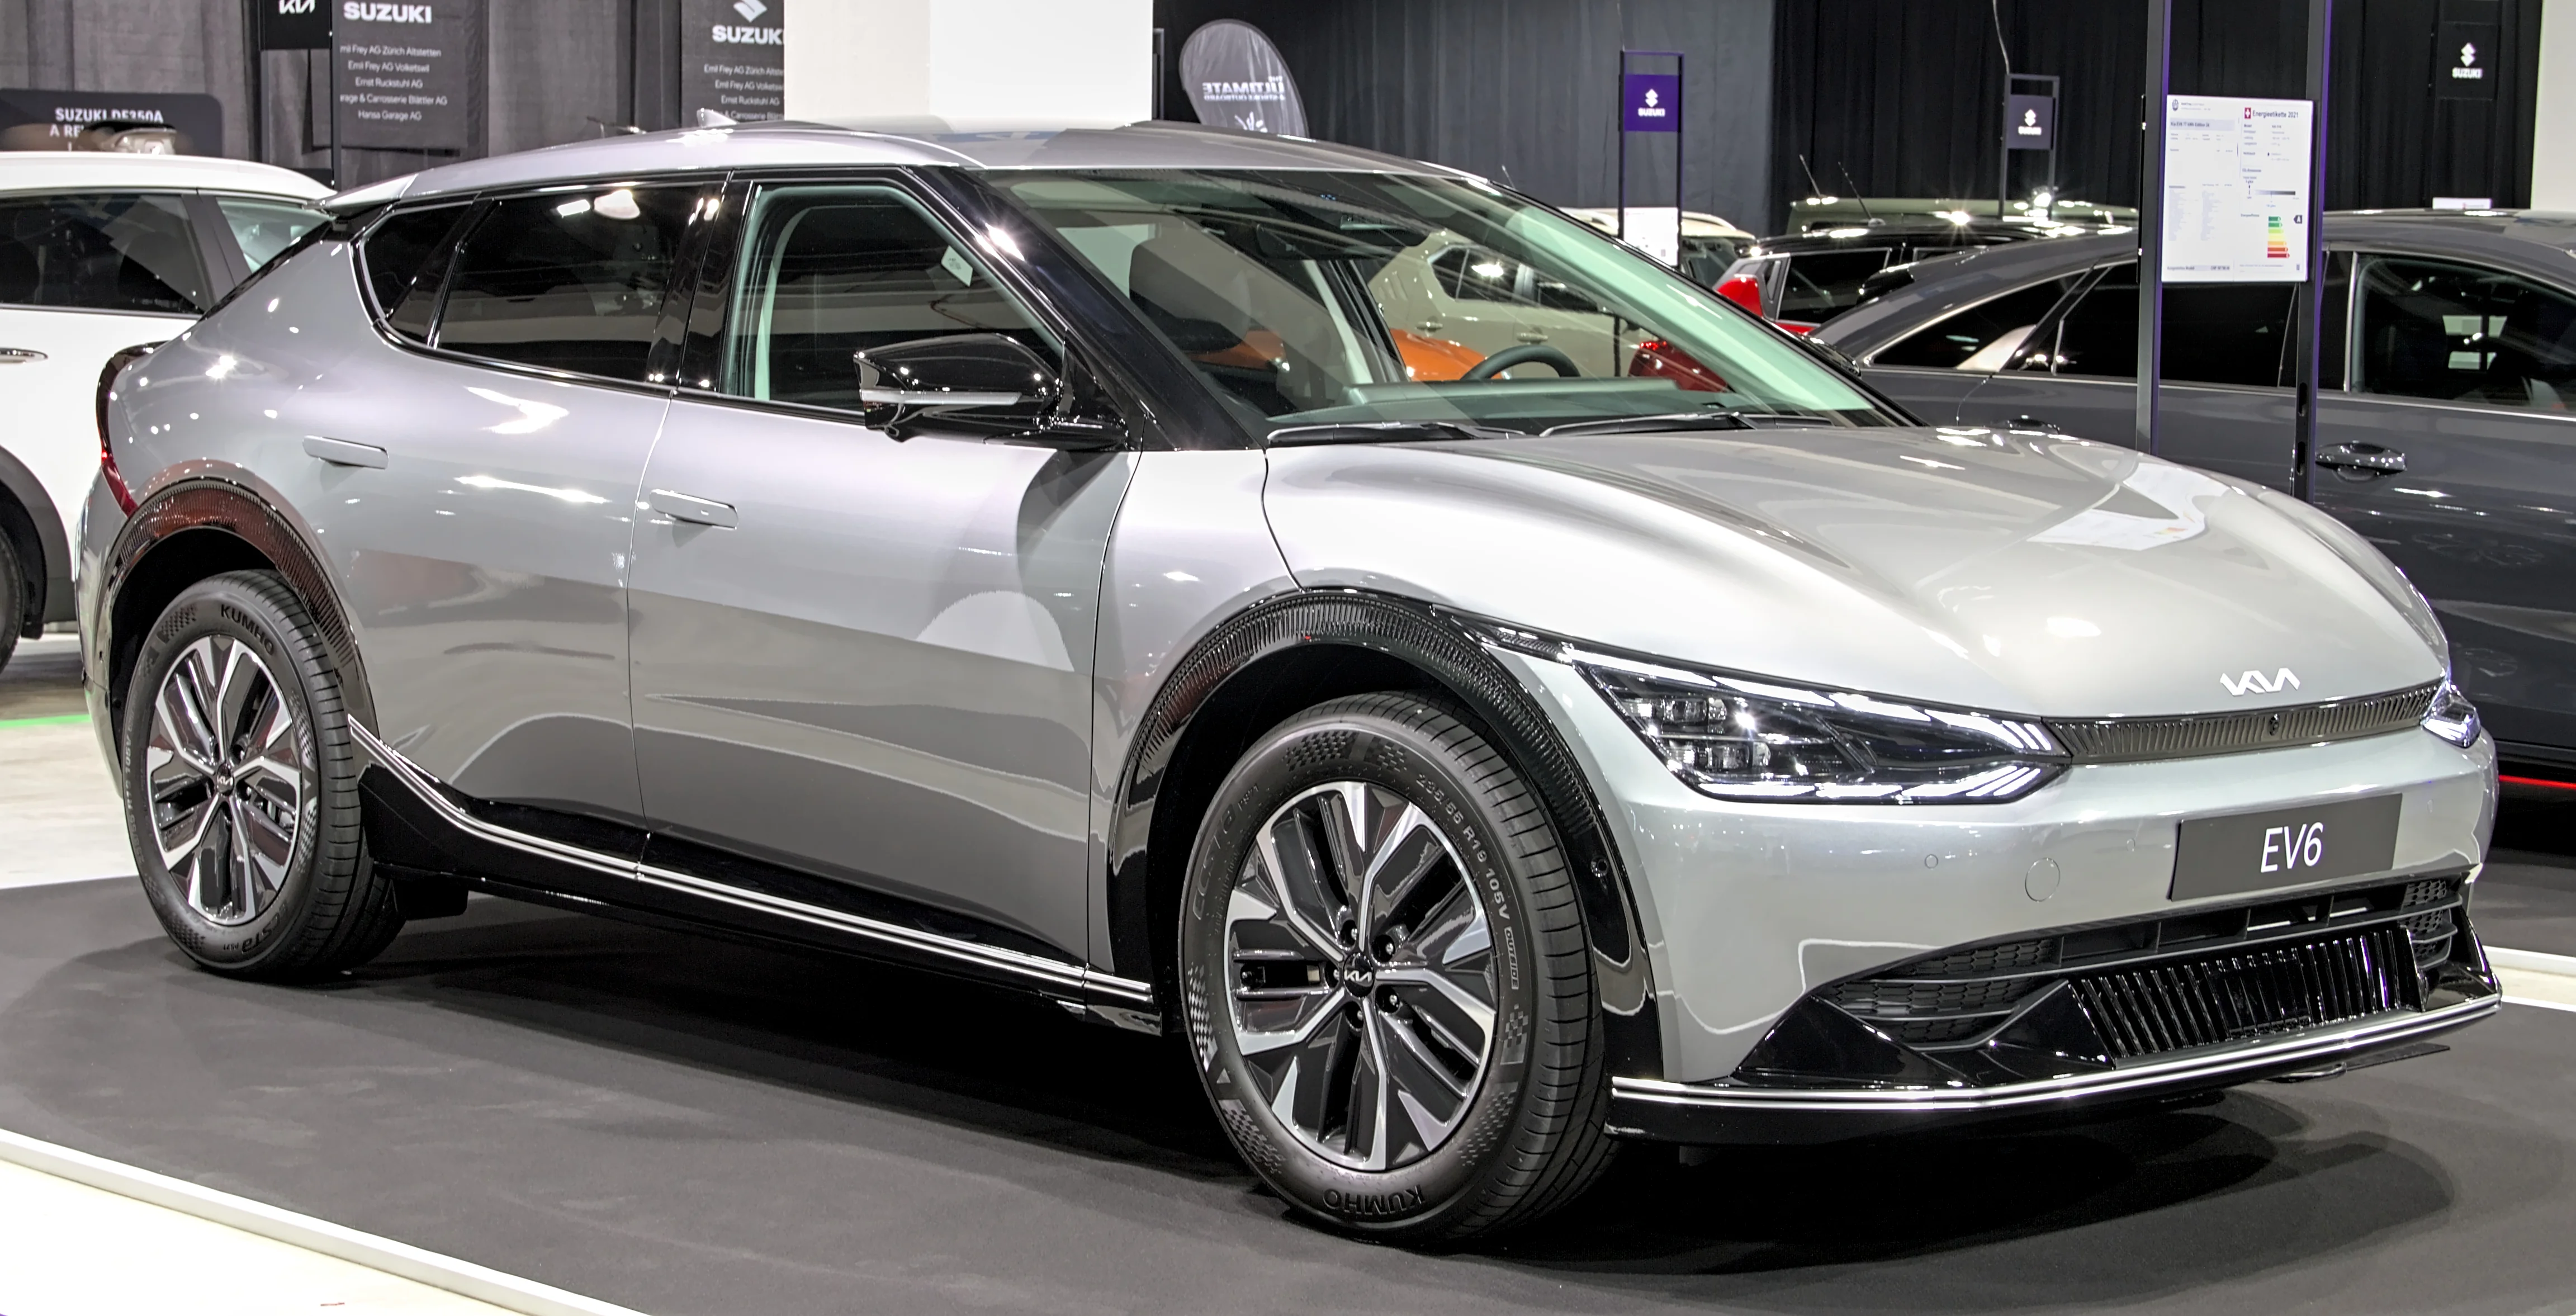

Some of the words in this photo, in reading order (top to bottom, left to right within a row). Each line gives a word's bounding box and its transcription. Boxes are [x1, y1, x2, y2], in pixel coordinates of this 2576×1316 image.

[343, 1, 432, 23] SUZUKI
[712, 25, 784, 45] SUZUK
[339, 45, 351, 54] mil
[352, 44, 368, 56] Frey
[370, 45, 381, 55] AG
[382, 45, 405, 56] Zürich
[406, 46, 442, 57] Altstetten
[348, 60, 364, 70] Emil
[365, 60, 381, 73] Frey
[382, 61, 394, 72] AG
[394, 63, 430, 73] Volketswil
[704, 64, 718, 73] Emil
[719, 64, 733, 76] Frey
[734, 65, 745, 74] AG
[2452, 67, 2483, 79] SUZUKI
[355, 77, 374, 87] Ernst
[375, 77, 410, 88] Ruckstuhl
[411, 79, 423, 88] AG
[715, 79, 729, 89] Emil
[730, 80, 744, 92] Frey
[744, 81, 755, 90] AG
[359, 93, 366, 103] &
[367, 93, 408, 105] Carrosserie
[435, 96, 448, 106] AG
[721, 94, 738, 105] Ernst
[738, 95, 769, 106] Ruckstuhl
[769, 96, 780, 106] AG
[55, 107, 108, 122] SUZUKI
[358, 110, 381, 119] Hansa
[381, 110, 409, 122] Garage
[410, 111, 423, 121] AG
[1638, 107, 1665, 117] SUZUKI
[2252, 110, 2287, 119] Energieetikette
[49, 123, 60, 138] A
[221, 604, 274, 656] KUMHO
[2220, 668, 2300, 696] KIA
[2260, 822, 2324, 873] EV6
[1416, 773, 1464, 825] 235/55
[1462, 825, 1488, 863] R19
[1485, 868, 1510, 920] 105V
[1504, 926, 1519, 990] OUTSIDE
[1344, 969, 1372, 983] KIA
[1323, 1184, 1426, 1216] KUMHO
